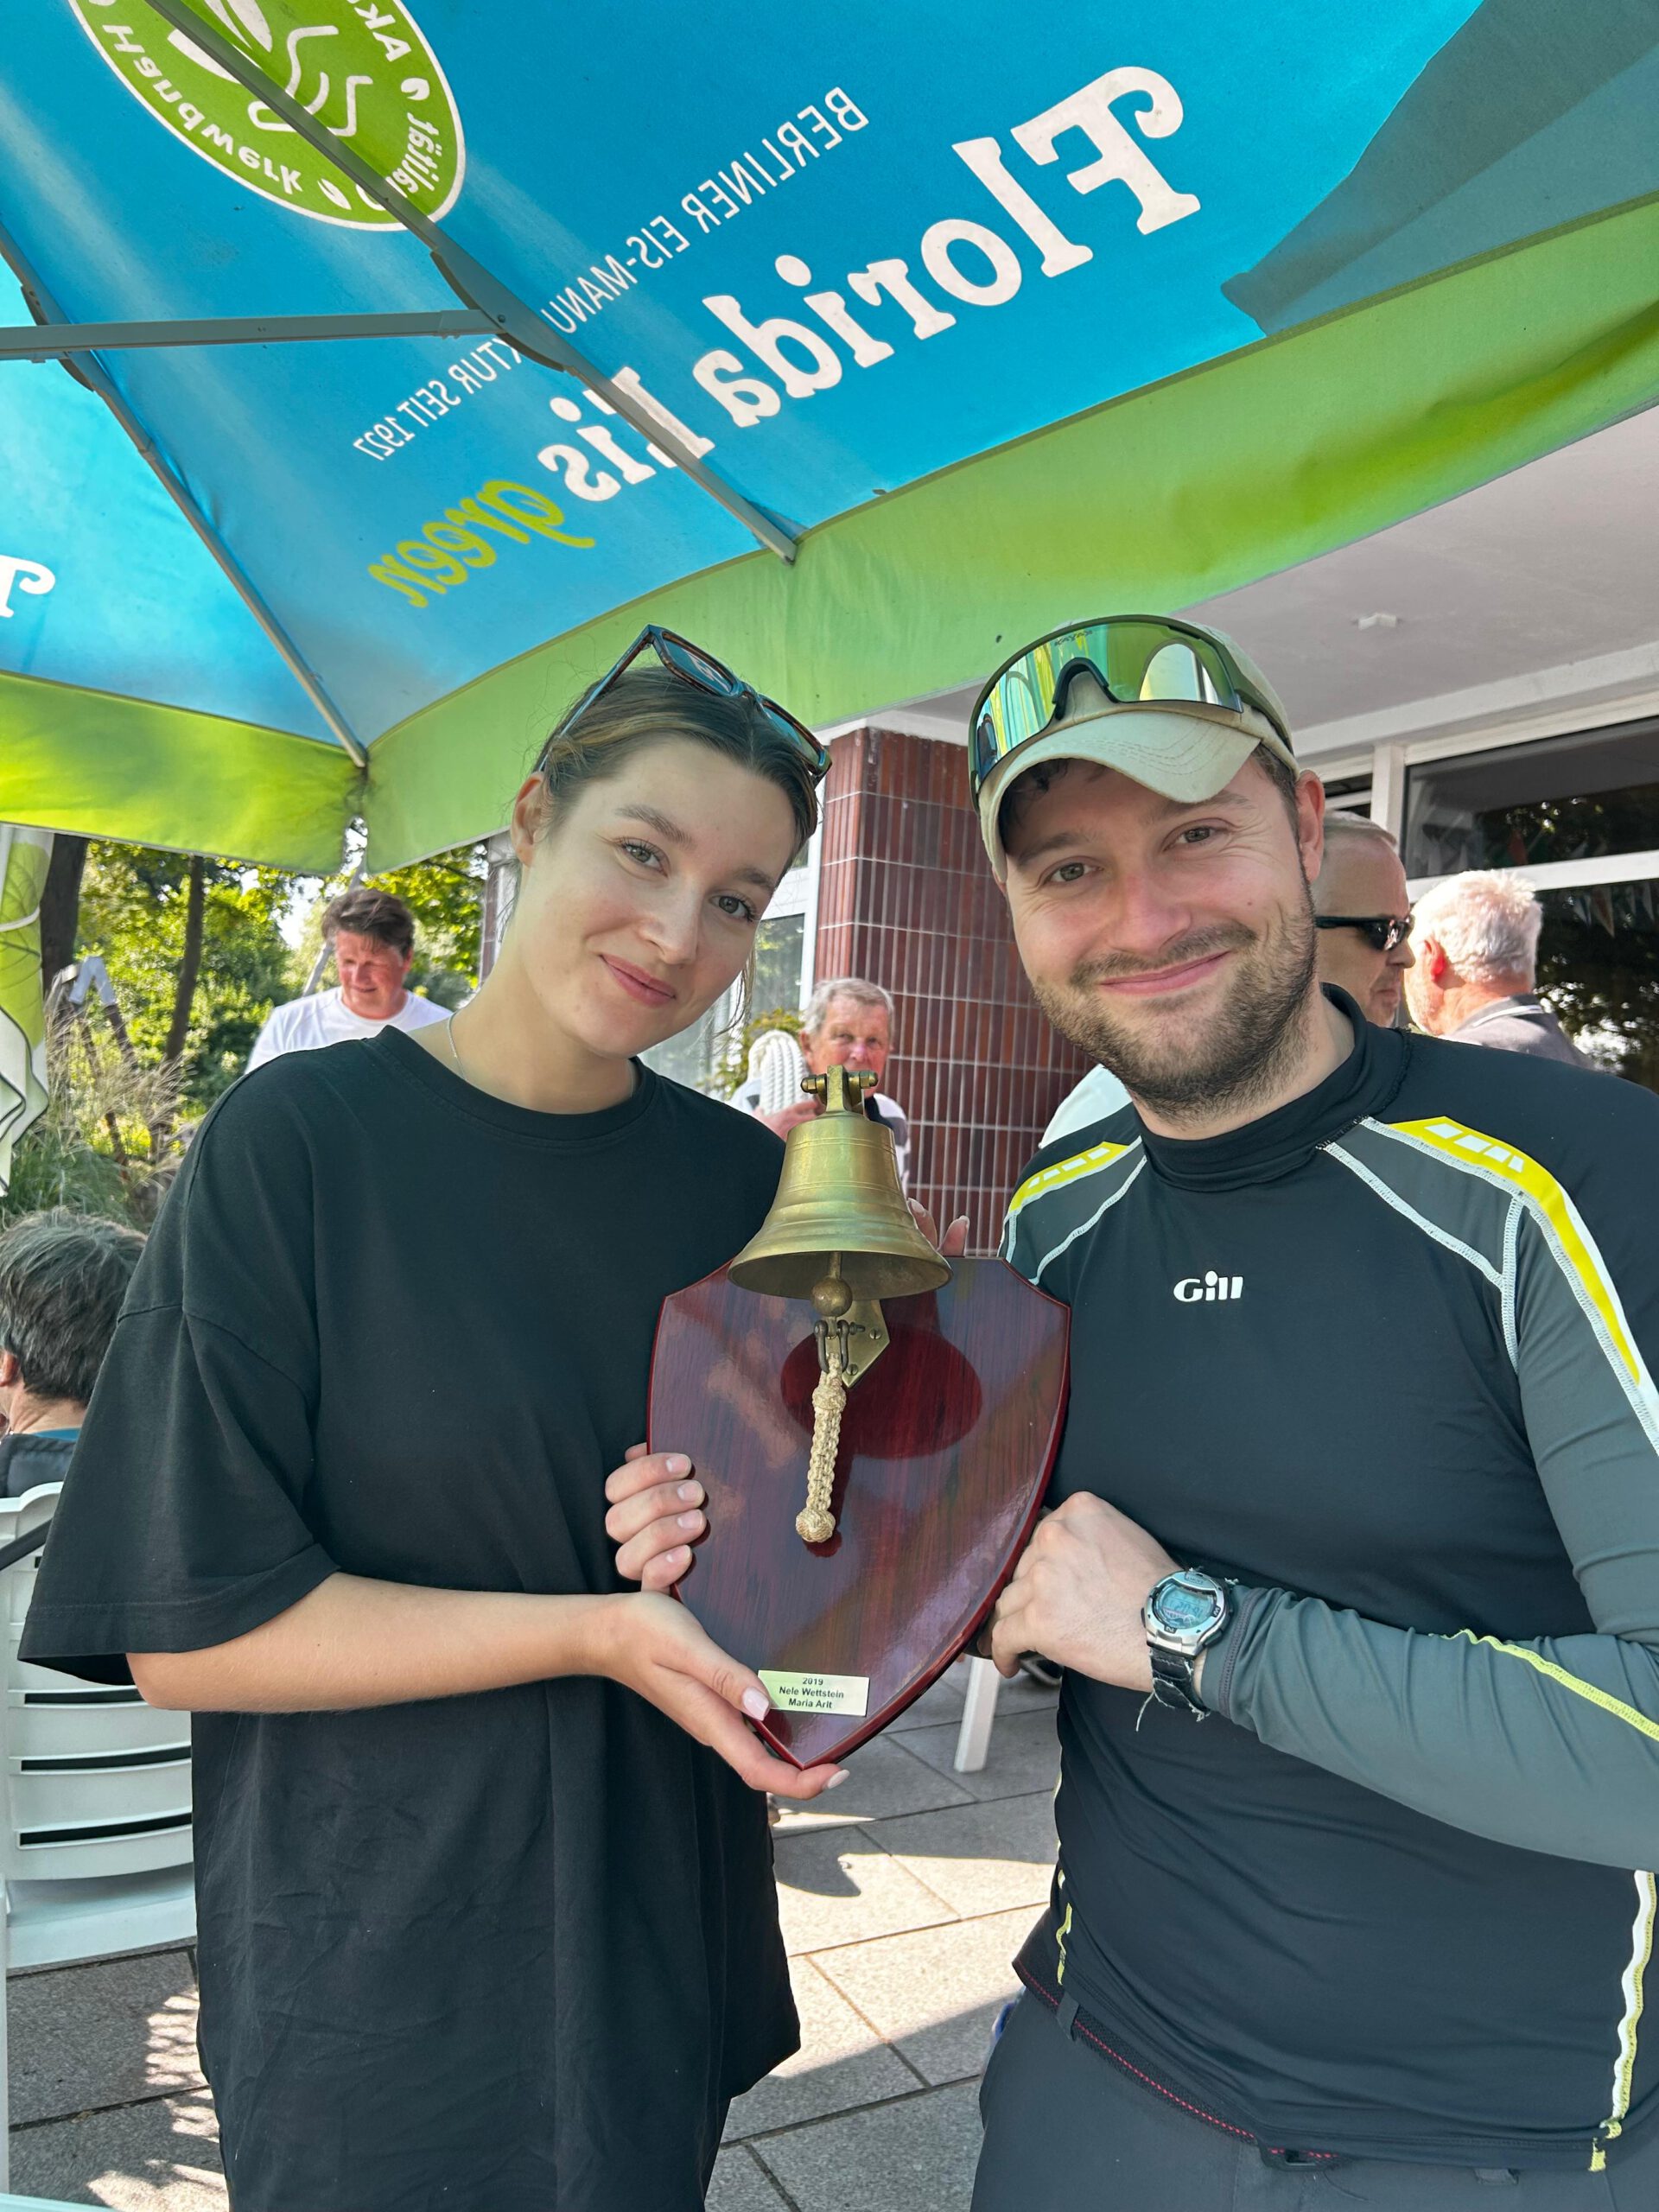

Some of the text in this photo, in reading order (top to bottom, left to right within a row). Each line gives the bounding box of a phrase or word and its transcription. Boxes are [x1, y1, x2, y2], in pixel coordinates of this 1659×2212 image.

[1173, 1270, 1243, 1302] Gill
[802, 1677, 823, 1686] 2019
[779, 1686, 844, 1699] Nele Wettstein
[788, 1698, 813, 1707] Maria
